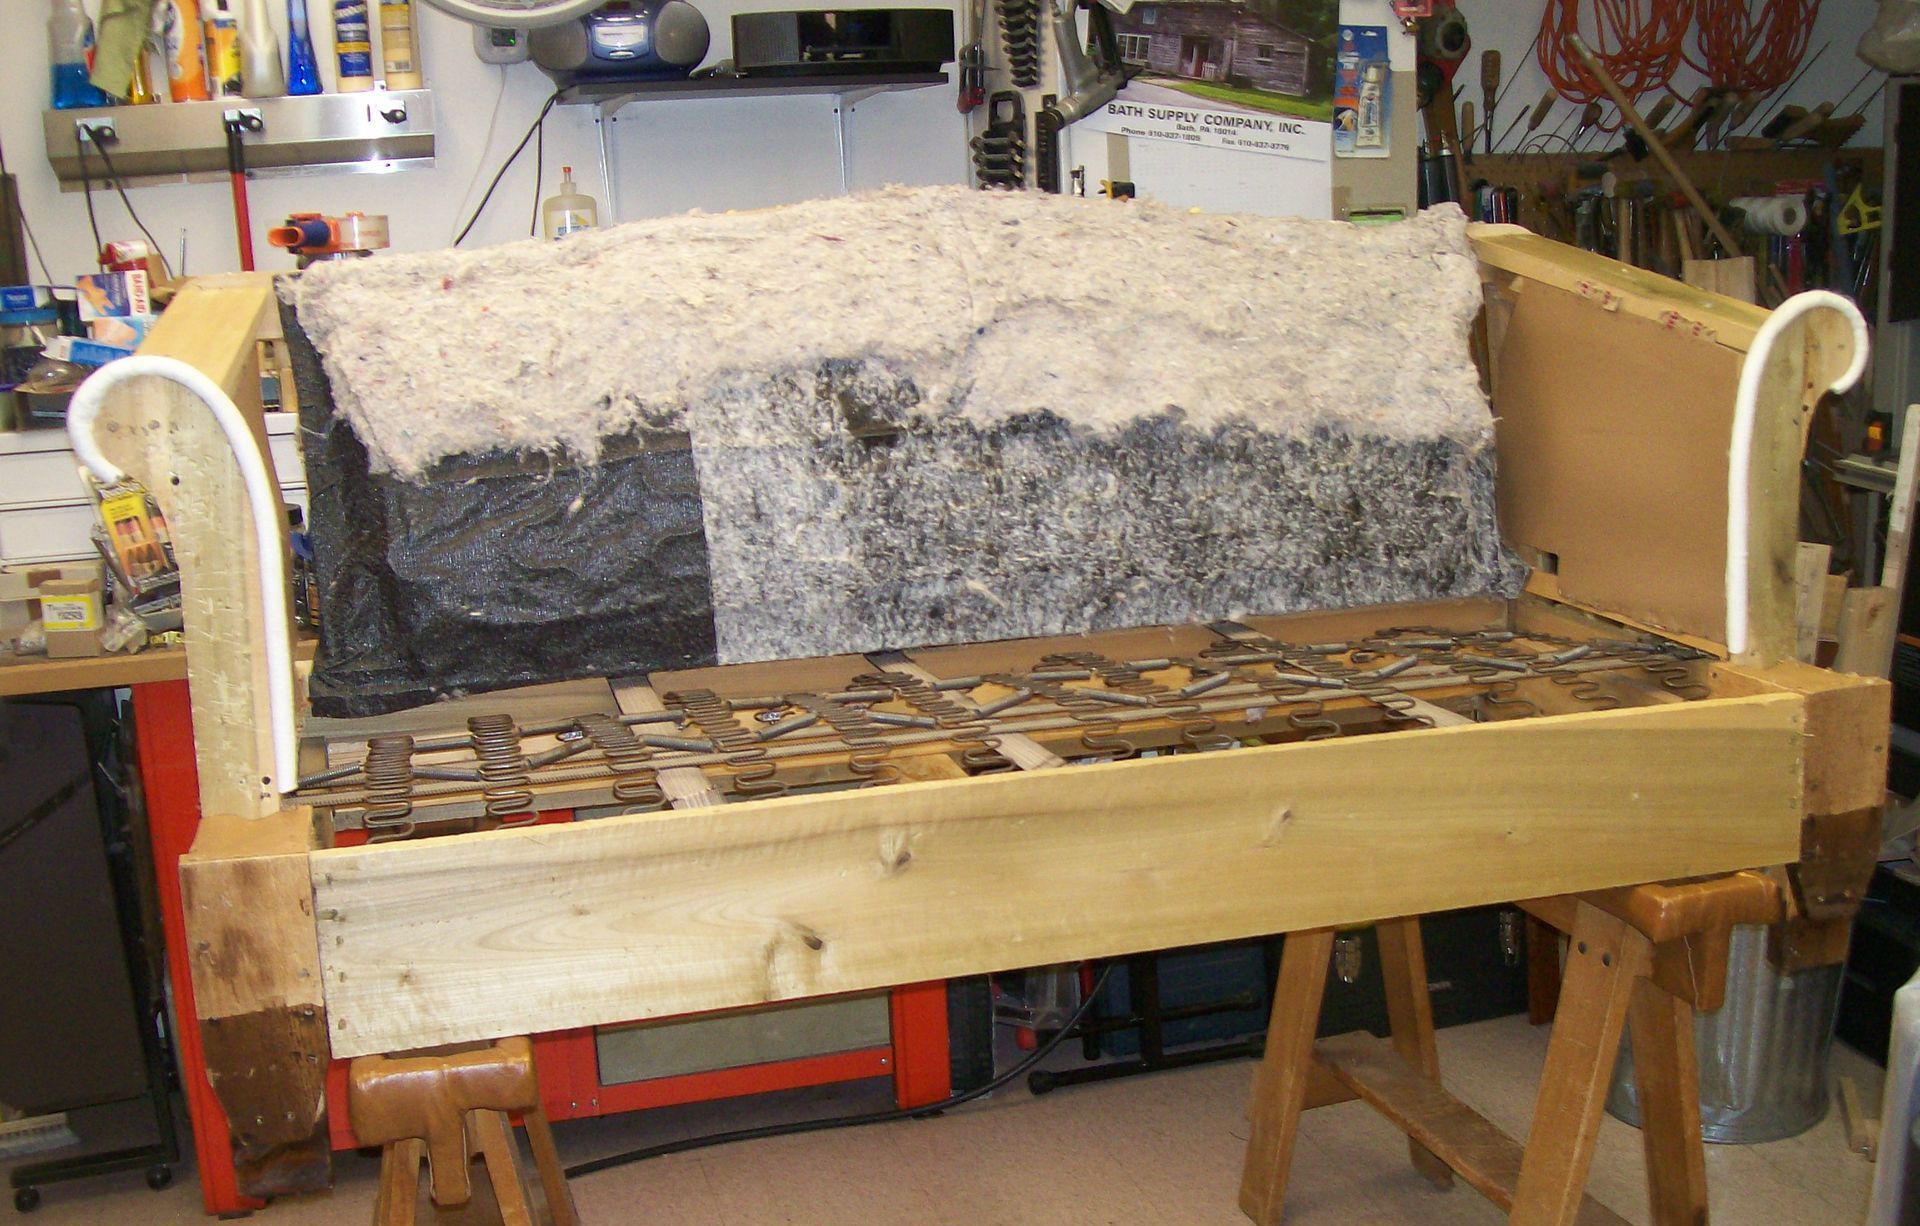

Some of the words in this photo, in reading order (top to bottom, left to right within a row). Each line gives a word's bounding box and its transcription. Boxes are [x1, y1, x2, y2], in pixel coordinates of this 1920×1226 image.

[1107, 103, 1143, 118] BATH
[1148, 107, 1198, 123] SUPPLY
[1278, 122, 1306, 135] INC.
